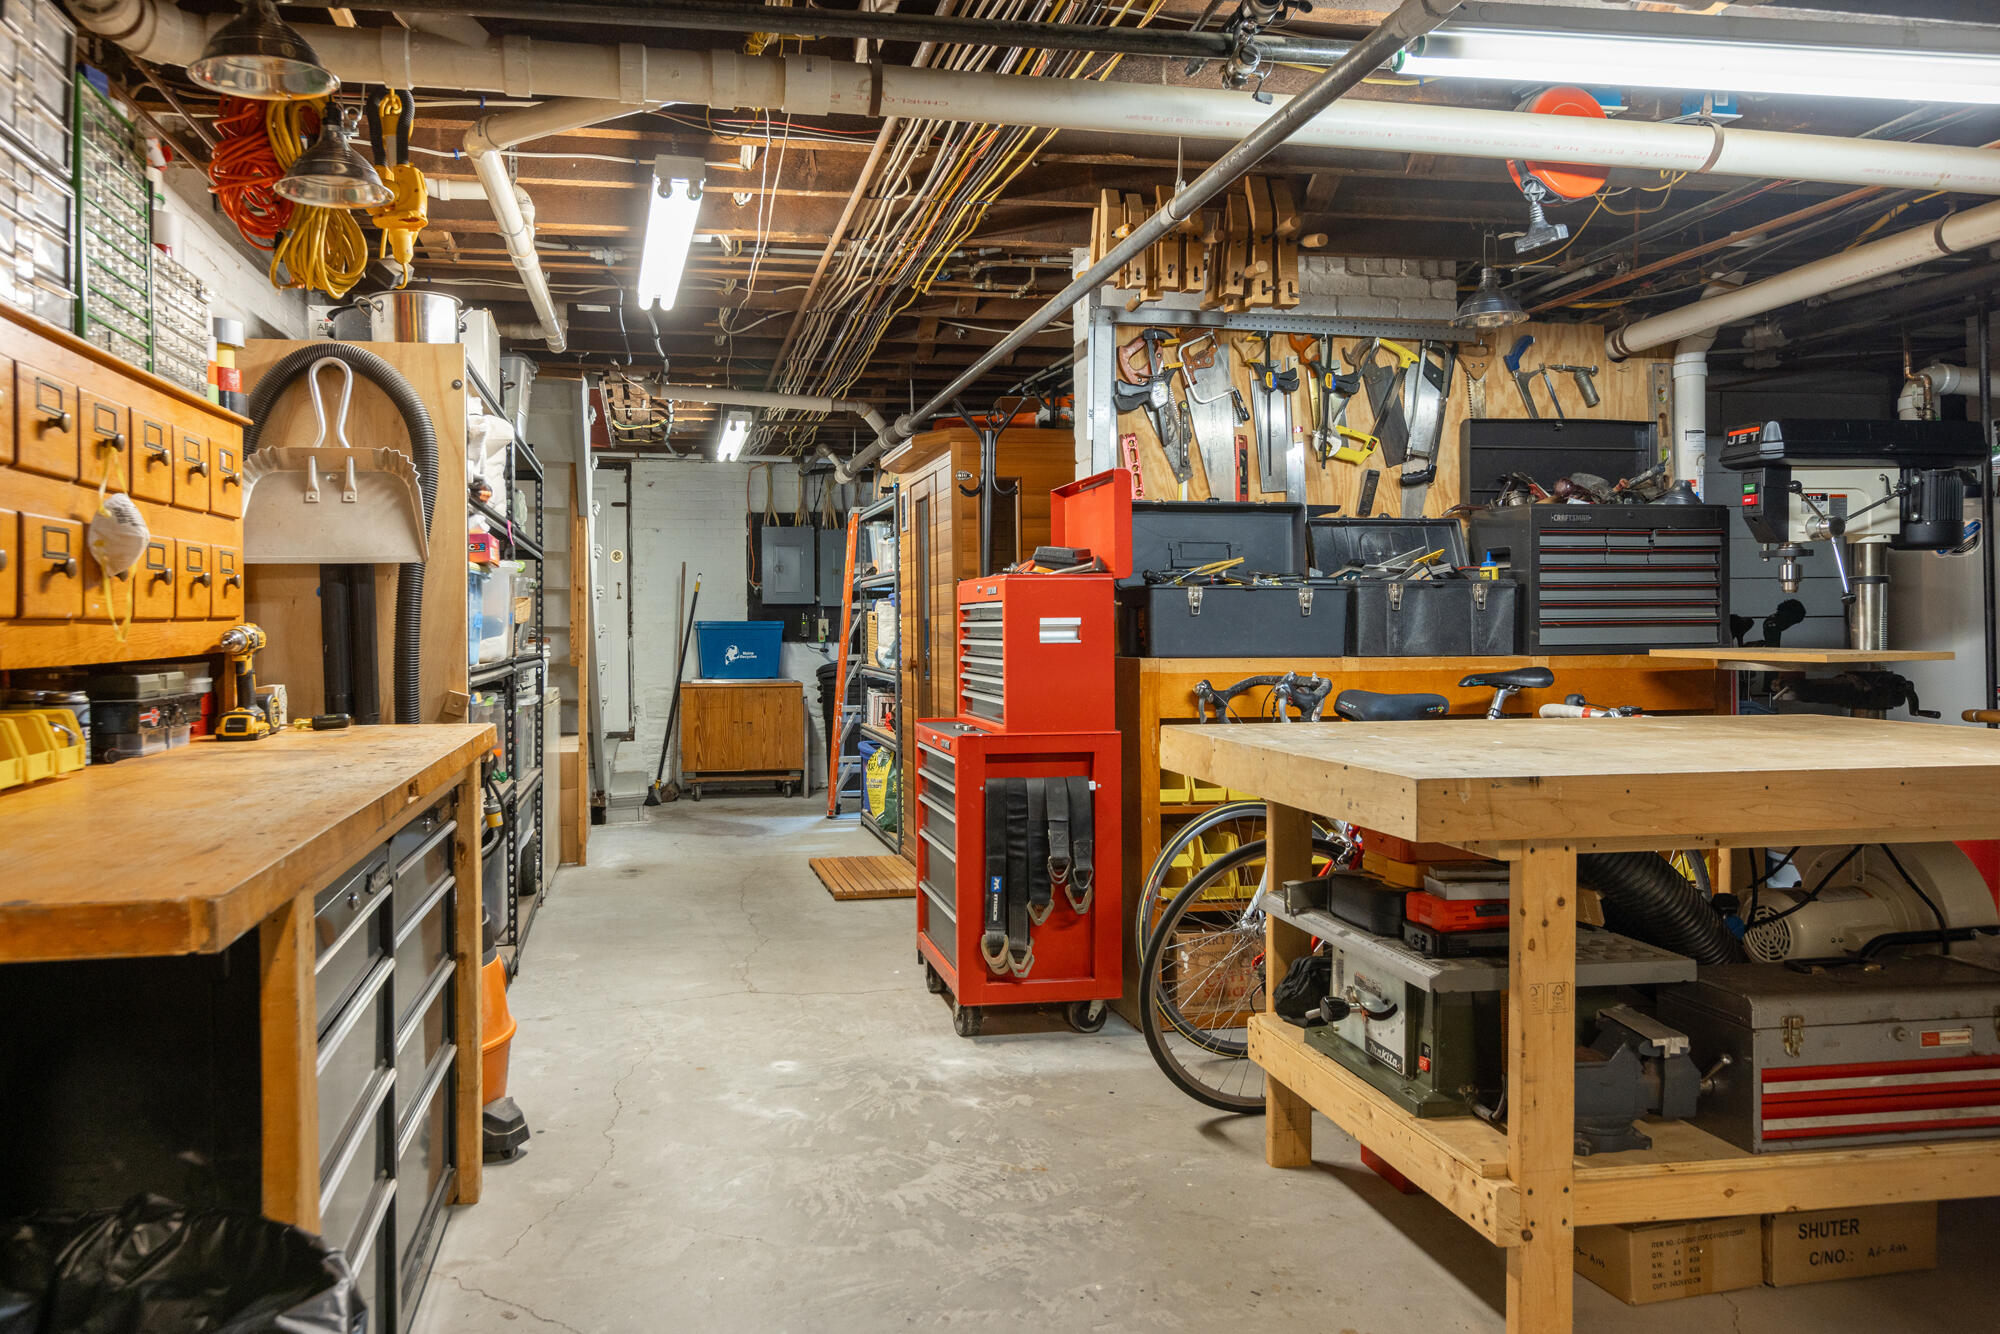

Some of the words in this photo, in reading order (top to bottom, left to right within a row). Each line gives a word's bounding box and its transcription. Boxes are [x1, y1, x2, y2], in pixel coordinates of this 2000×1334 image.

[1728, 431, 1760, 445] JET
[1798, 1218, 1861, 1240] SHUTER
[1809, 1248, 1854, 1266] C/NO.:
